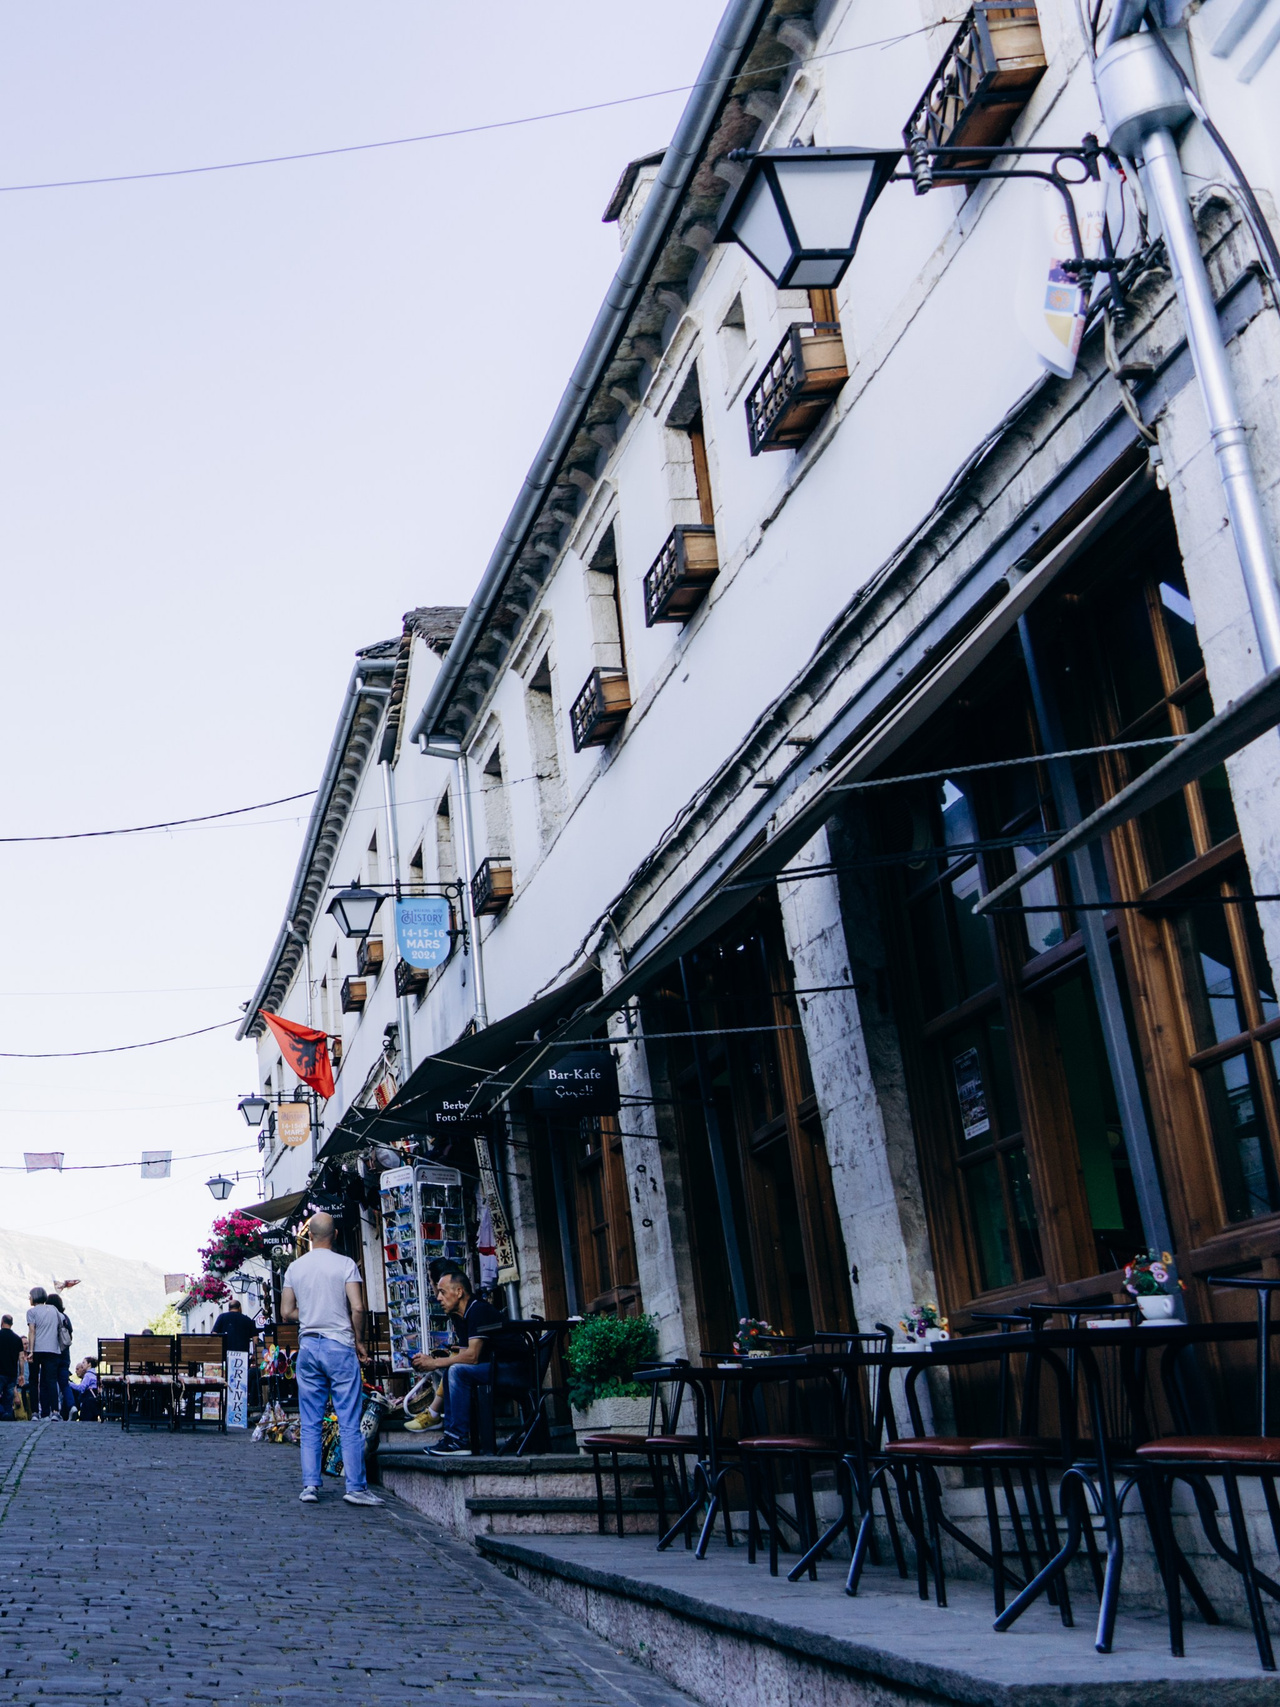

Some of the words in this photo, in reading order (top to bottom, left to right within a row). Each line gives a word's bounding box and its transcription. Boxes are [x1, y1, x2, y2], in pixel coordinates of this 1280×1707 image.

[401, 909, 443, 925] HISTORY
[402, 929, 445, 938] 14-15-16
[406, 940, 441, 949] MARS
[411, 950, 437, 960] 2024
[548, 1068, 601, 1080] Bar-Kafe
[442, 1100, 470, 1110] Berbe
[436, 1113, 457, 1122] Foto
[233, 1358, 244, 1423] DRINKS
